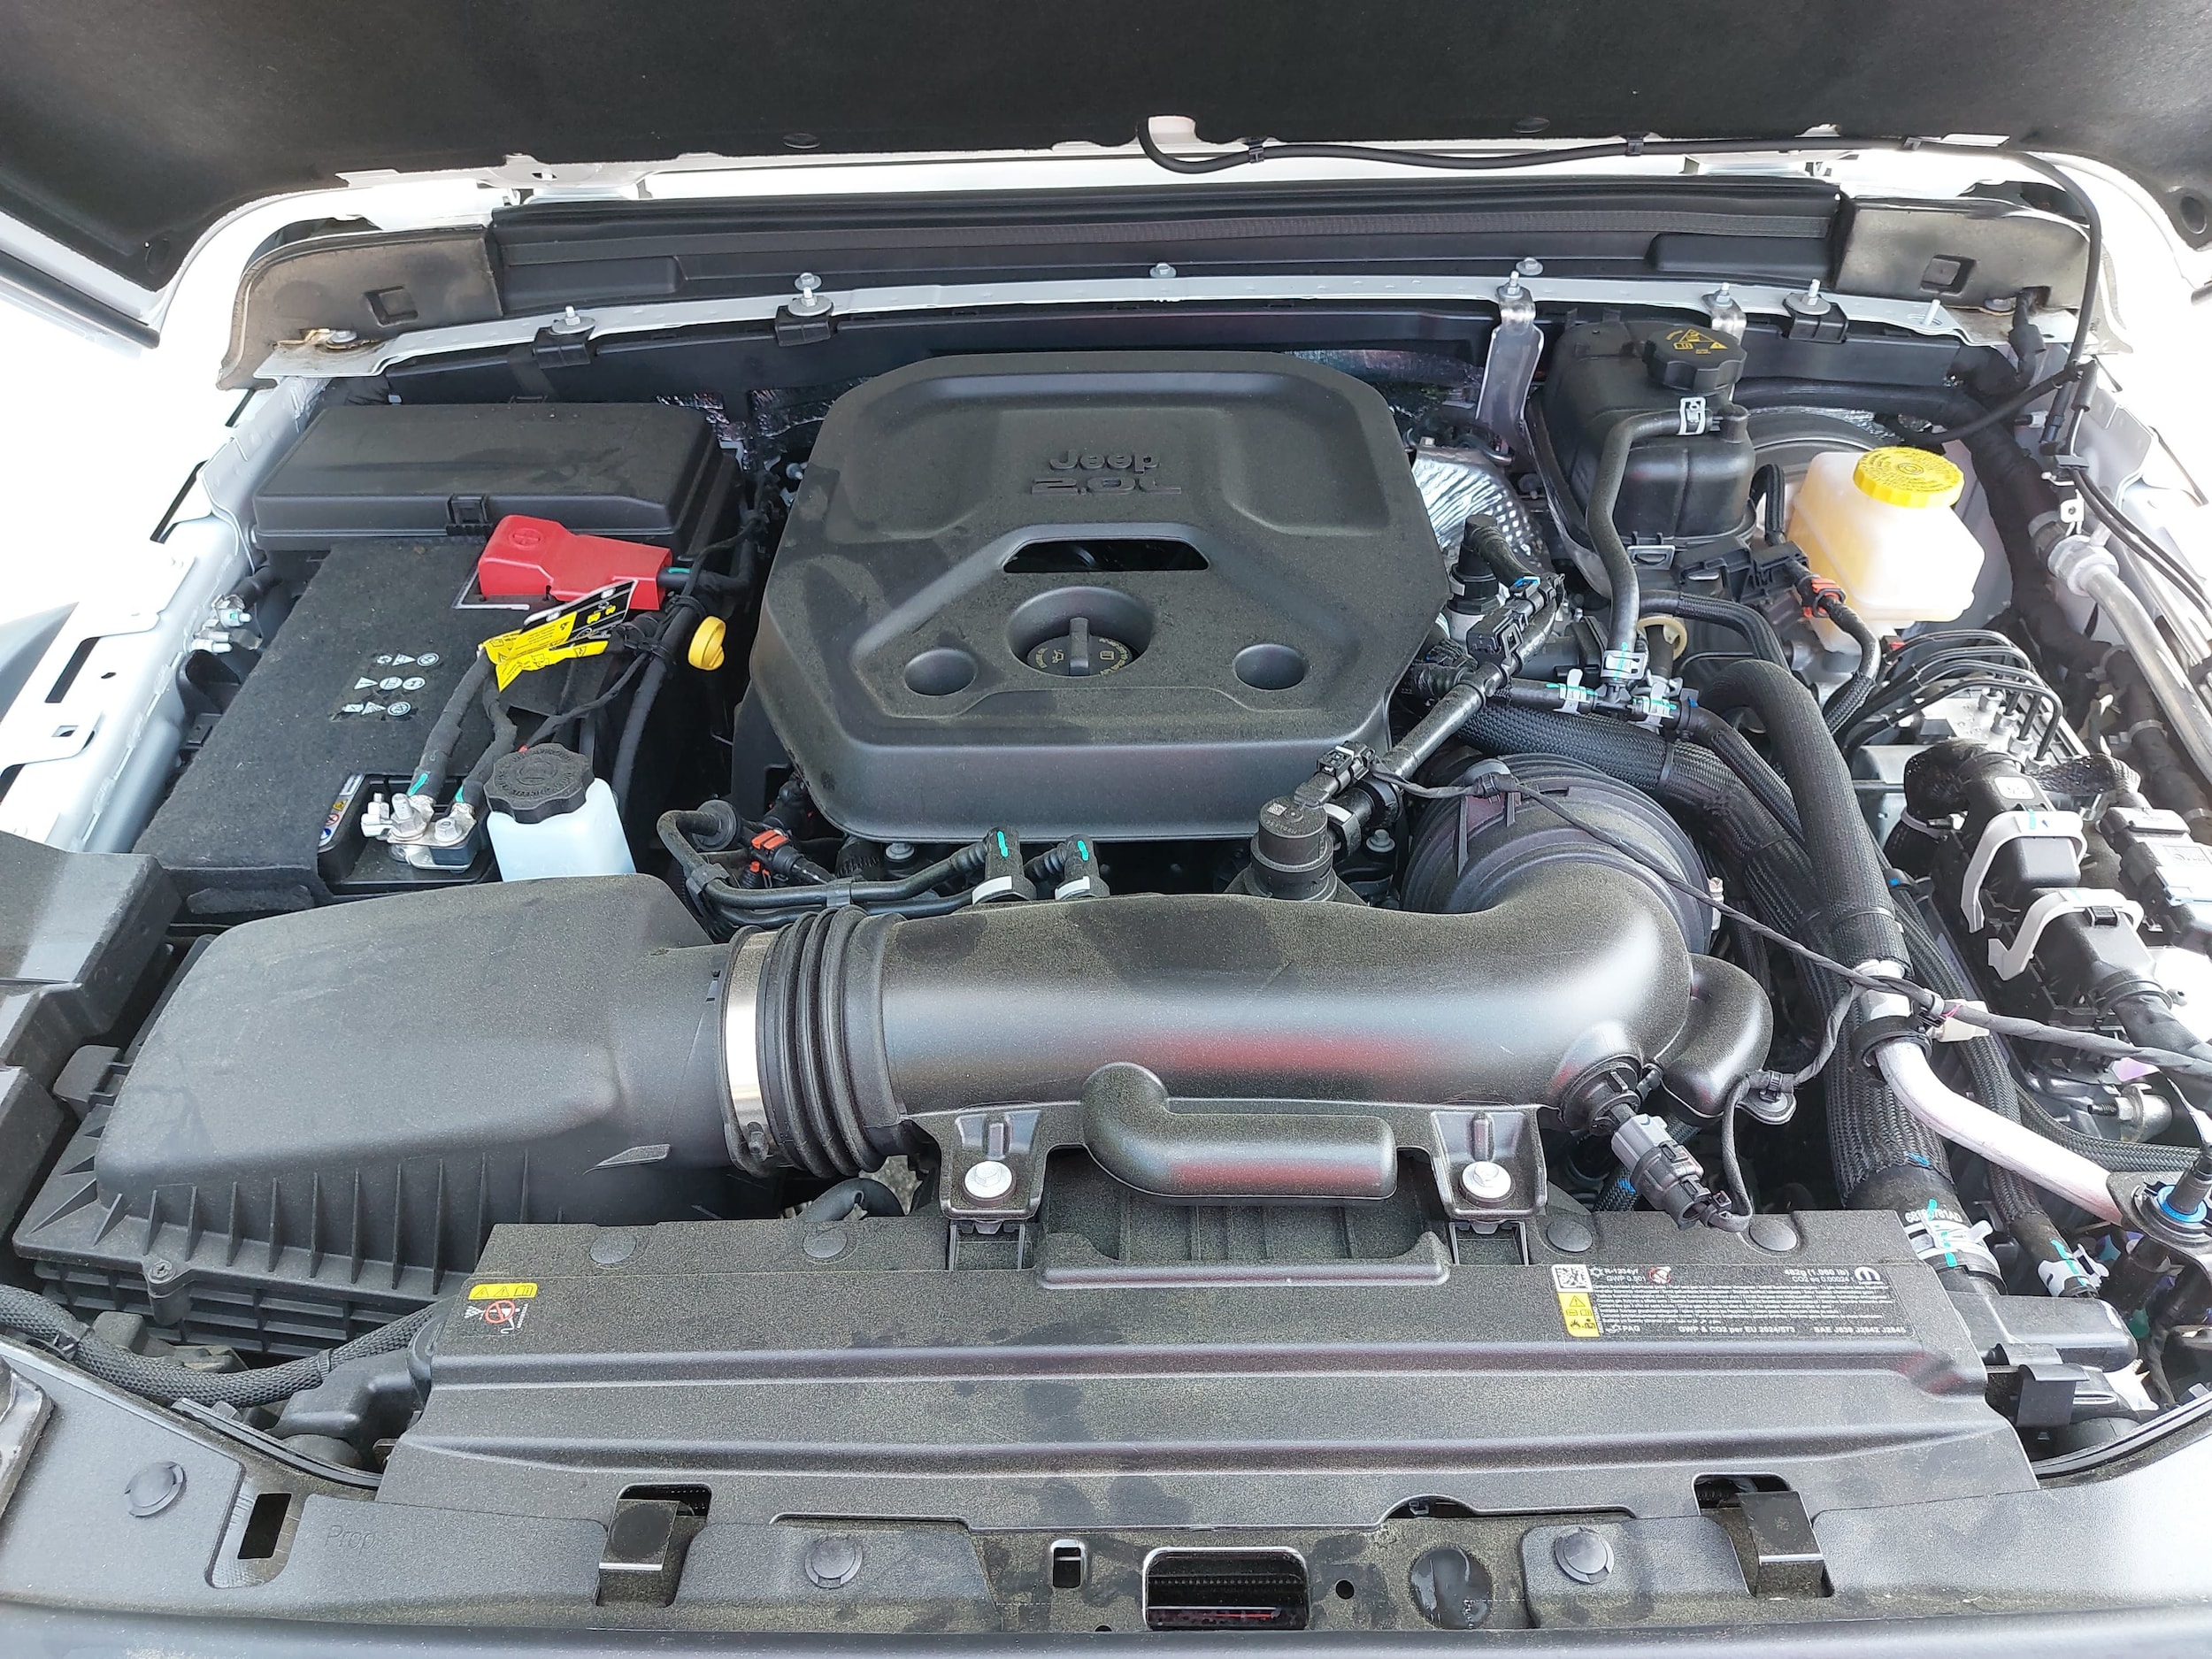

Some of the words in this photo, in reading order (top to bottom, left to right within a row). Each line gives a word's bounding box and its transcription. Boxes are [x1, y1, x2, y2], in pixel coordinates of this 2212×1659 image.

[1049, 449, 1161, 475] Jeep
[1031, 477, 1183, 495] 2.0L
[1784, 1268, 1807, 1277] 482g
[1836, 1268, 1850, 1277] lb)
